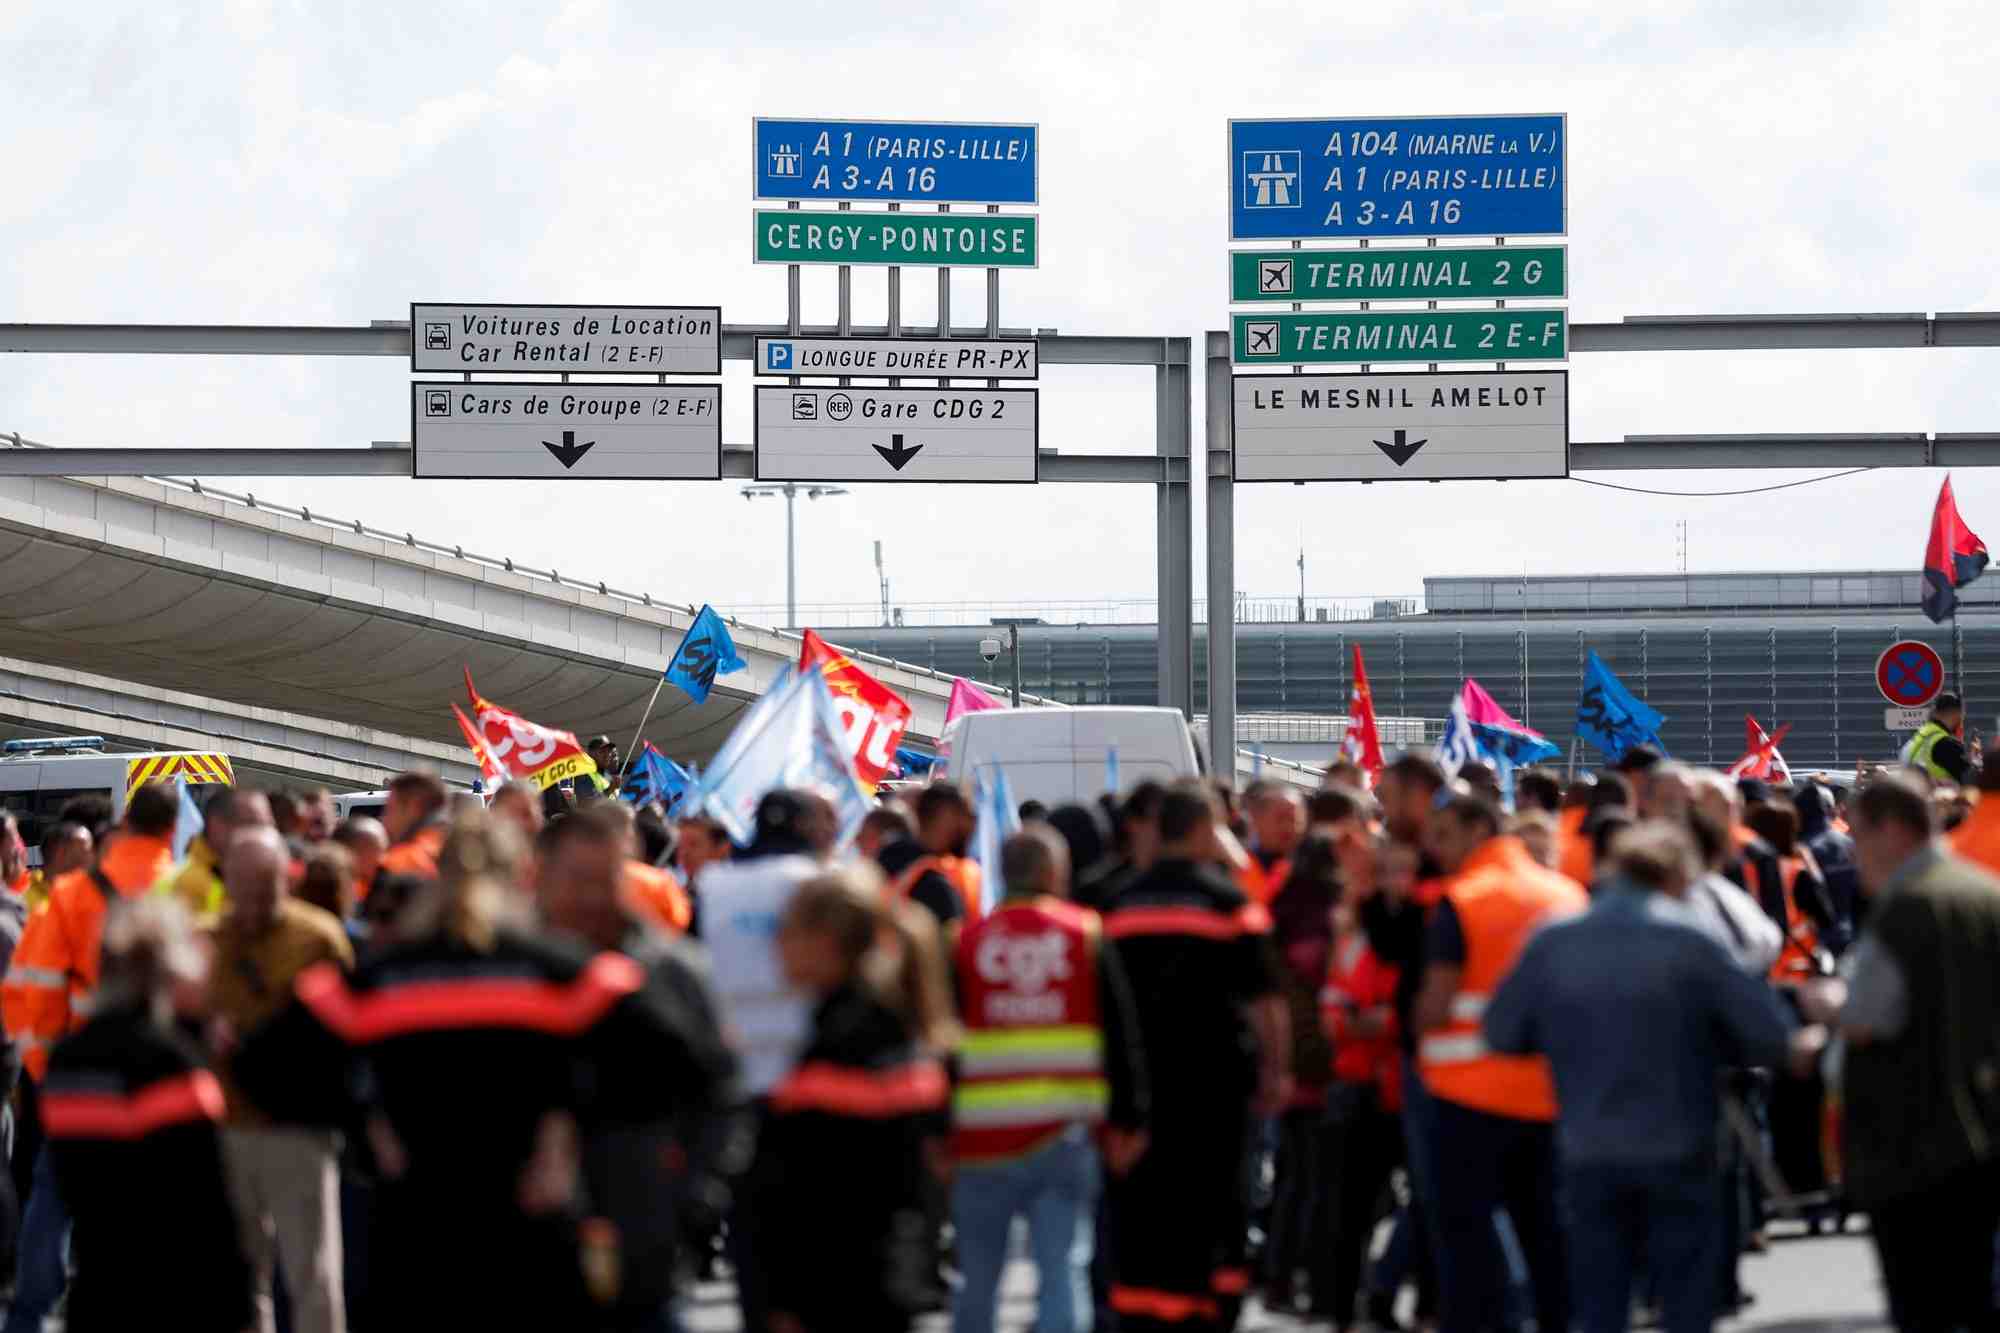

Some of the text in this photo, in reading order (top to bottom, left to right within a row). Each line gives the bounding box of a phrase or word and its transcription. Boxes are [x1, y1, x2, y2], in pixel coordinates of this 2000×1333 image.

[812, 131, 1028, 162] A 1 (PARIS-LILLE)
[1408, 134, 1495, 158] (MARNE
[1501, 141, 1519, 154] LA
[1324, 167, 1556, 191] A 1 (PARIS-LILLE)
[768, 224, 1025, 253] CERGY-PONTOISE
[1307, 260, 1543, 288] TERMINAL 2 G
[462, 315, 712, 336] Voitures de Location
[1294, 322, 1559, 350] TERMINAL 2 E-F
[461, 342, 501, 363] Car
[513, 341, 590, 362] Rental
[801, 348, 1030, 369] LONGUE DURÉE PR-PX
[461, 394, 512, 415] Cars
[523, 395, 549, 415] de
[560, 395, 641, 420] Groupe
[830, 402, 849, 413] RER
[862, 398, 1005, 419] Gare CDG 2
[1254, 387, 1546, 409] LE MESNIL AMELOT
[550, 759, 577, 780] CDG
